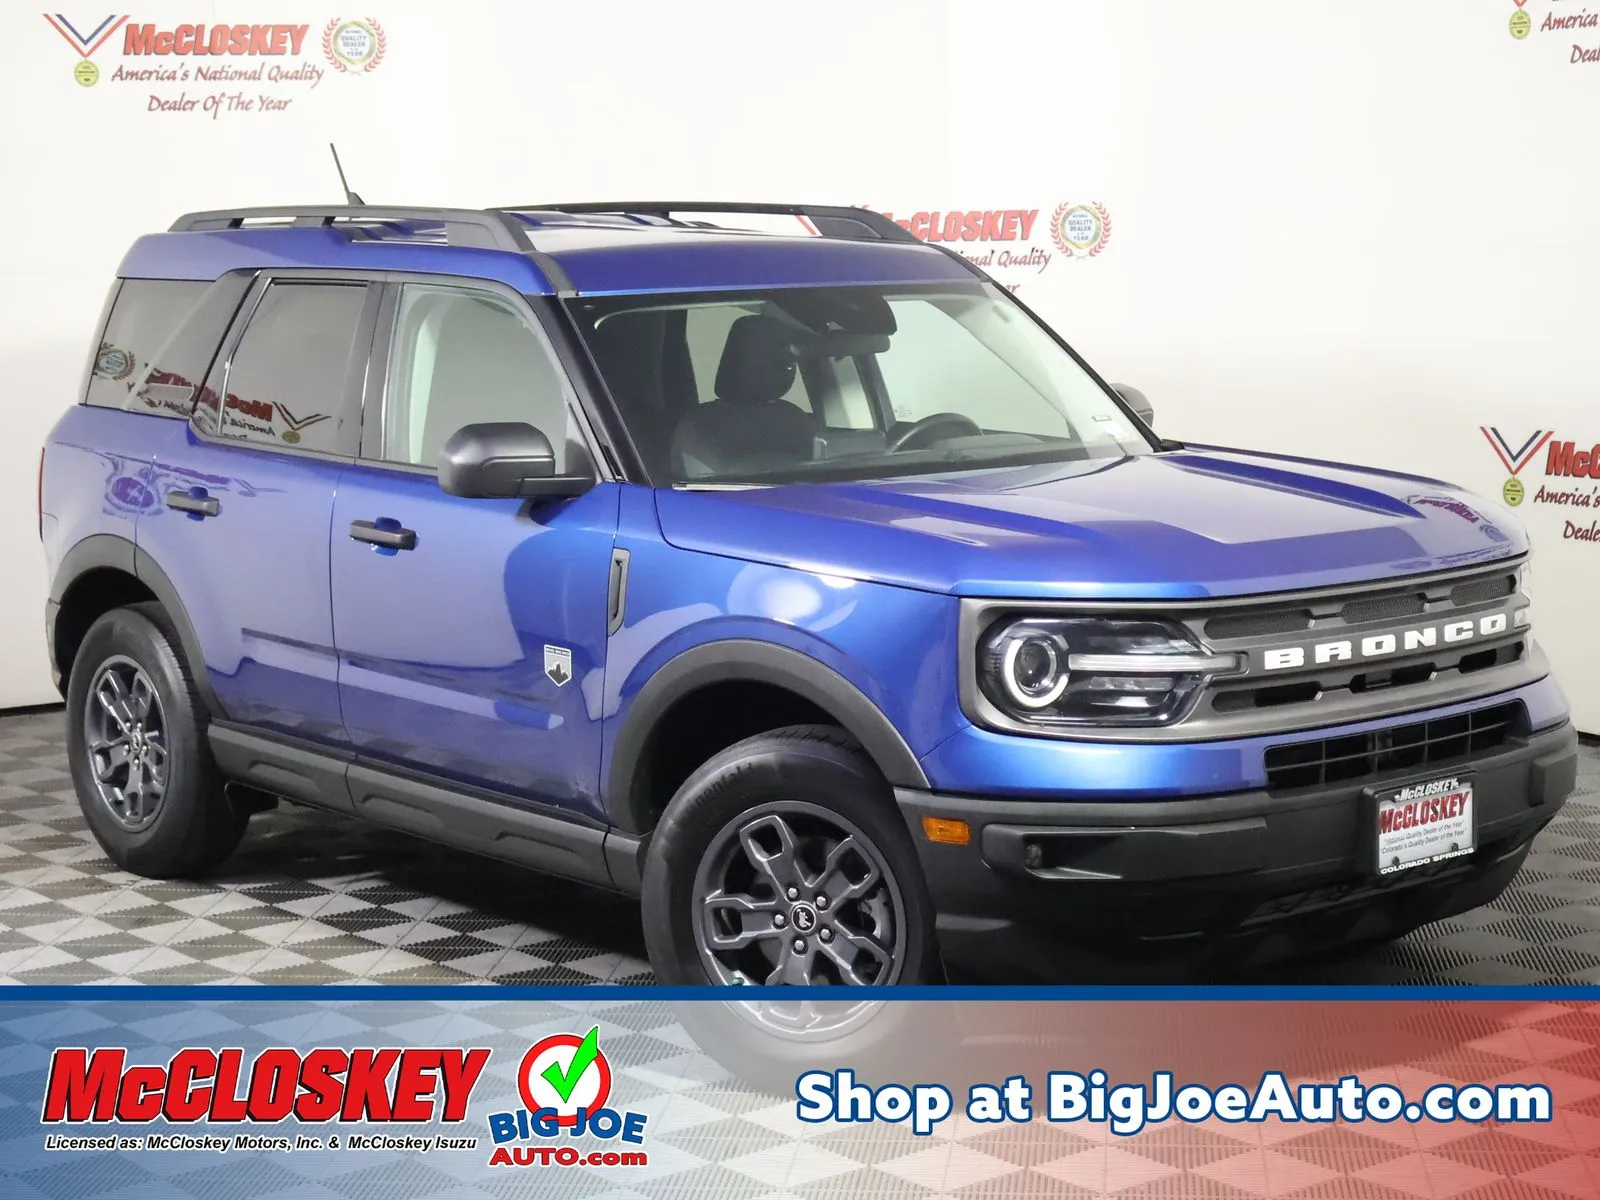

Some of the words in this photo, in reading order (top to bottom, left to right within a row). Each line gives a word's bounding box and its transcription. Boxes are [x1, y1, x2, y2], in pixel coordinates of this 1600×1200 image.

[123, 24, 310, 56] McCLOSKEY
[111, 62, 190, 82] America's
[194, 61, 266, 82] National
[267, 61, 325, 90] Quality
[147, 92, 201, 112] Dealer
[202, 91, 226, 120] Of
[227, 91, 254, 112] The
[258, 94, 293, 112] Year
[881, 209, 1040, 242] CLOSKEY
[998, 247, 1052, 274] Quality
[1264, 613, 1507, 670] BRONCO
[1378, 791, 1470, 835] McCLOSKEY
[1380, 857, 1431, 875] COLORADO
[1432, 847, 1474, 862] SPRINGS
